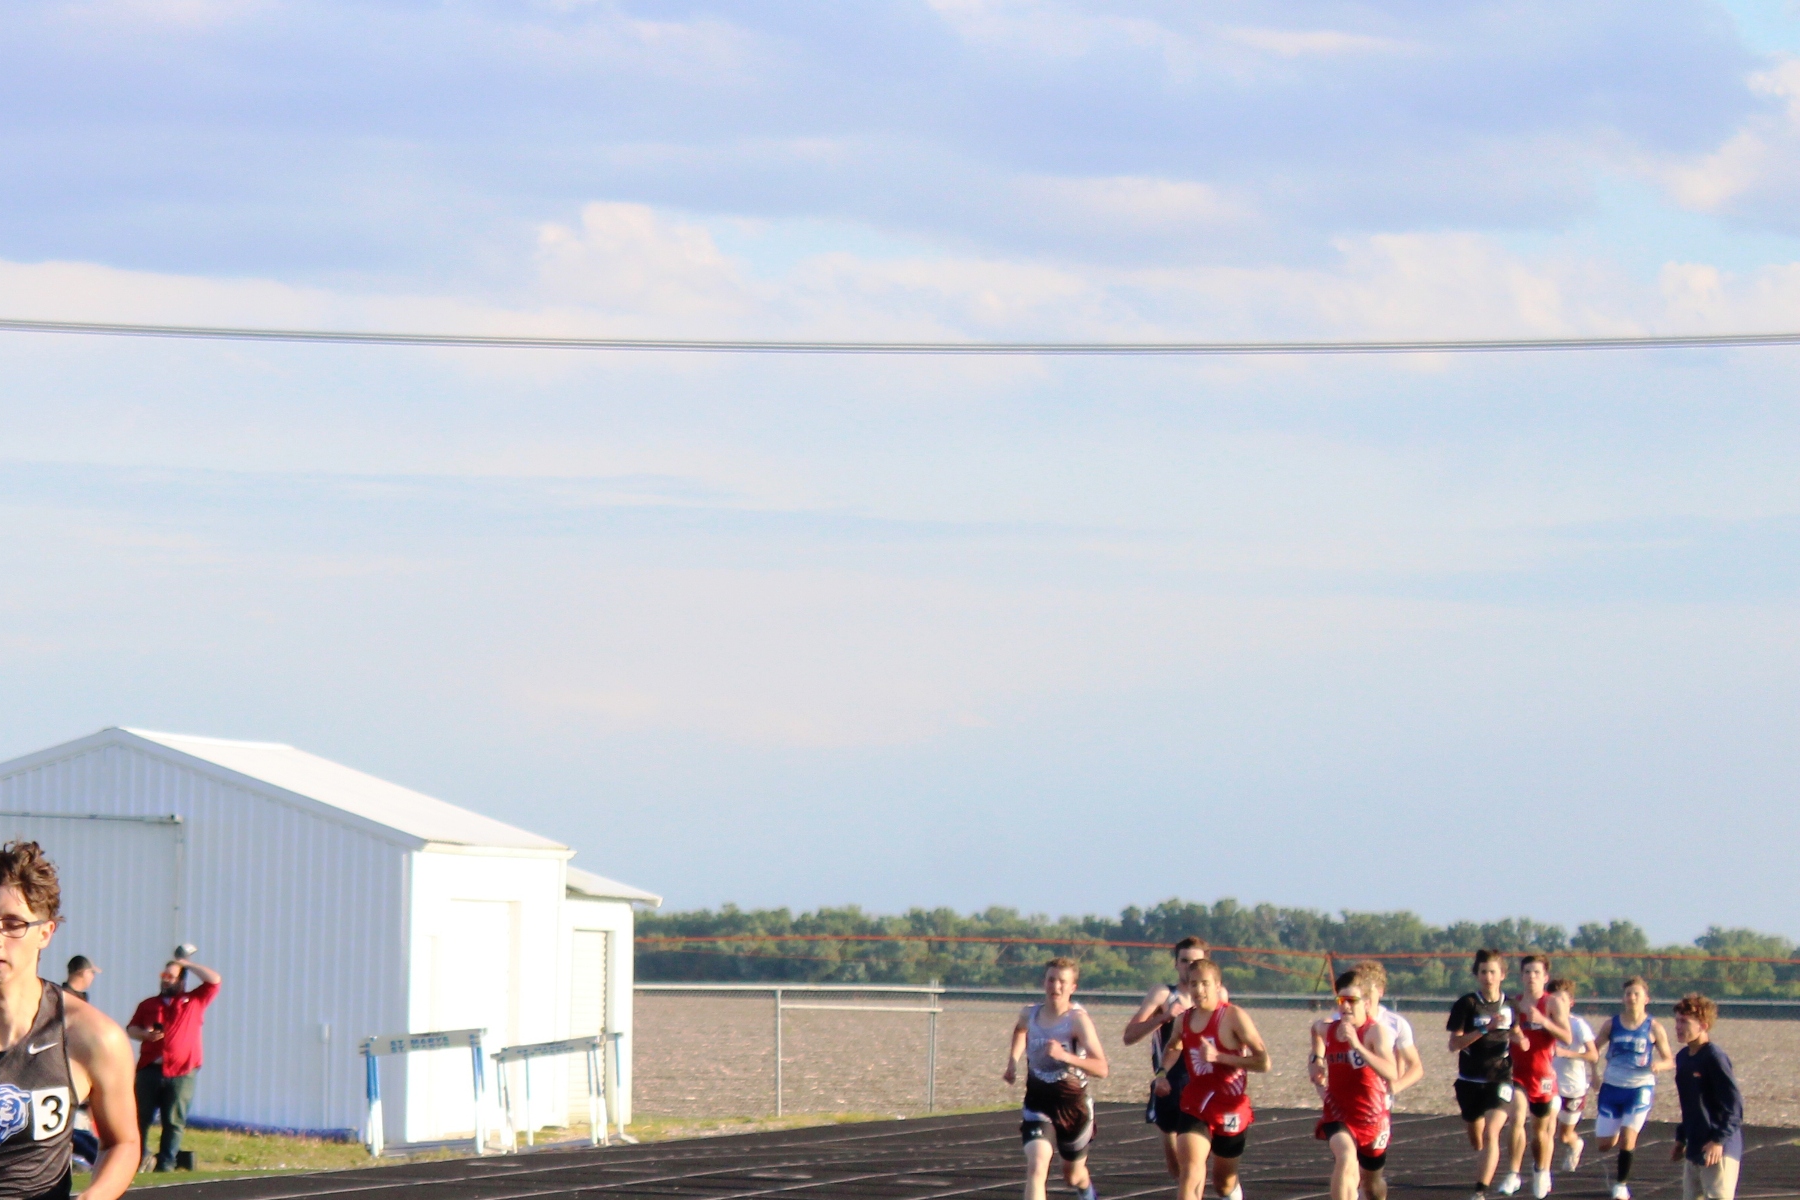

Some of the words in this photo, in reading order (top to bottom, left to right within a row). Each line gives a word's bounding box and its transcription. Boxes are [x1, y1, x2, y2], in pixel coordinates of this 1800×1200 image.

[1353, 1051, 1364, 1066] 8
[41, 1095, 63, 1132] 3
[1227, 1117, 1237, 1130] 4
[1379, 1133, 1388, 1147] 8
